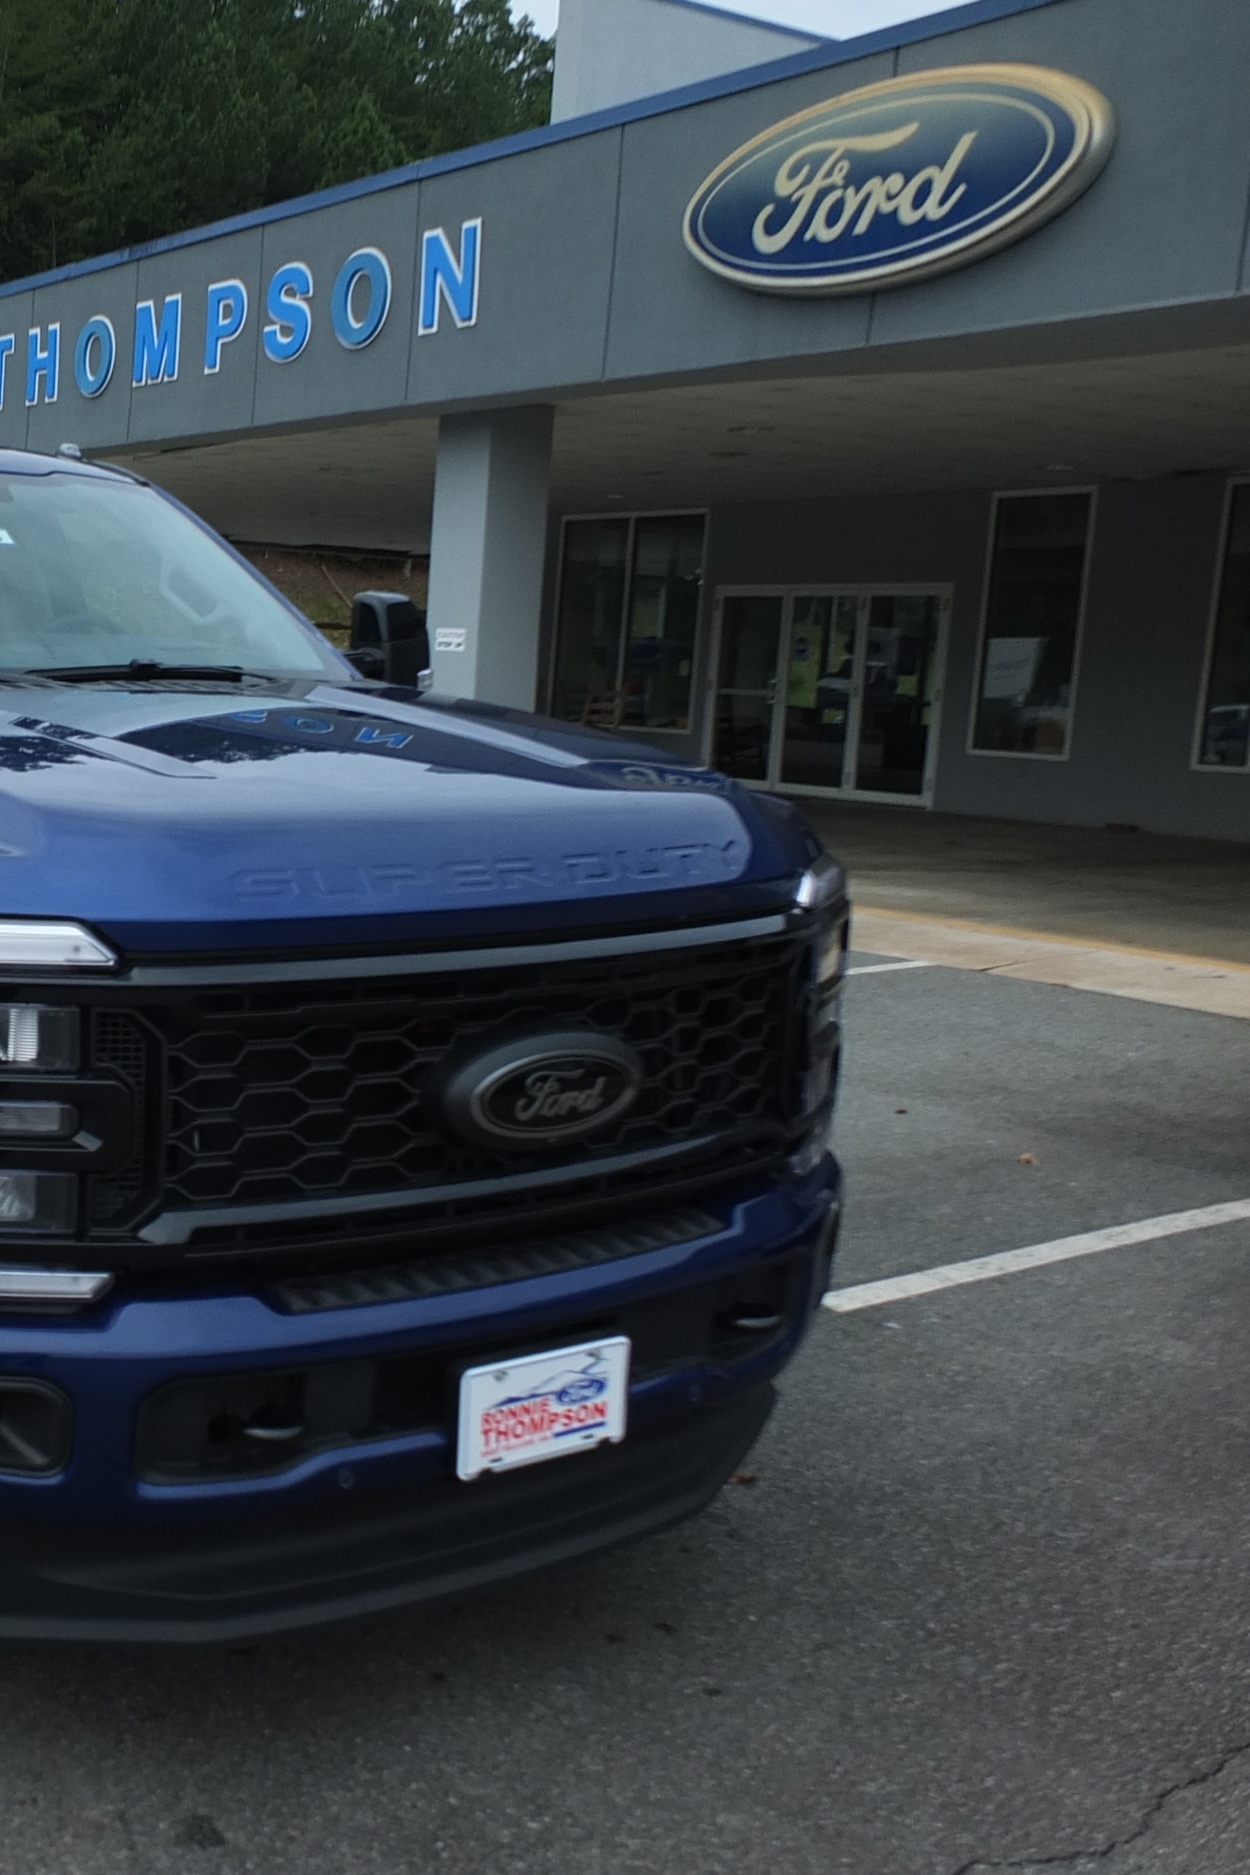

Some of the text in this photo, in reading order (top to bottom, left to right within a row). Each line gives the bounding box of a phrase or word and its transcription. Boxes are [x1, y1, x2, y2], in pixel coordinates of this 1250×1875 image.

[752, 121, 978, 255] Ford
[230, 839, 738, 900] SUPER DUTY
[514, 1069, 606, 1121] Ford
[481, 1397, 551, 1428] RONNIE
[481, 1401, 608, 1447] THOMPSON
